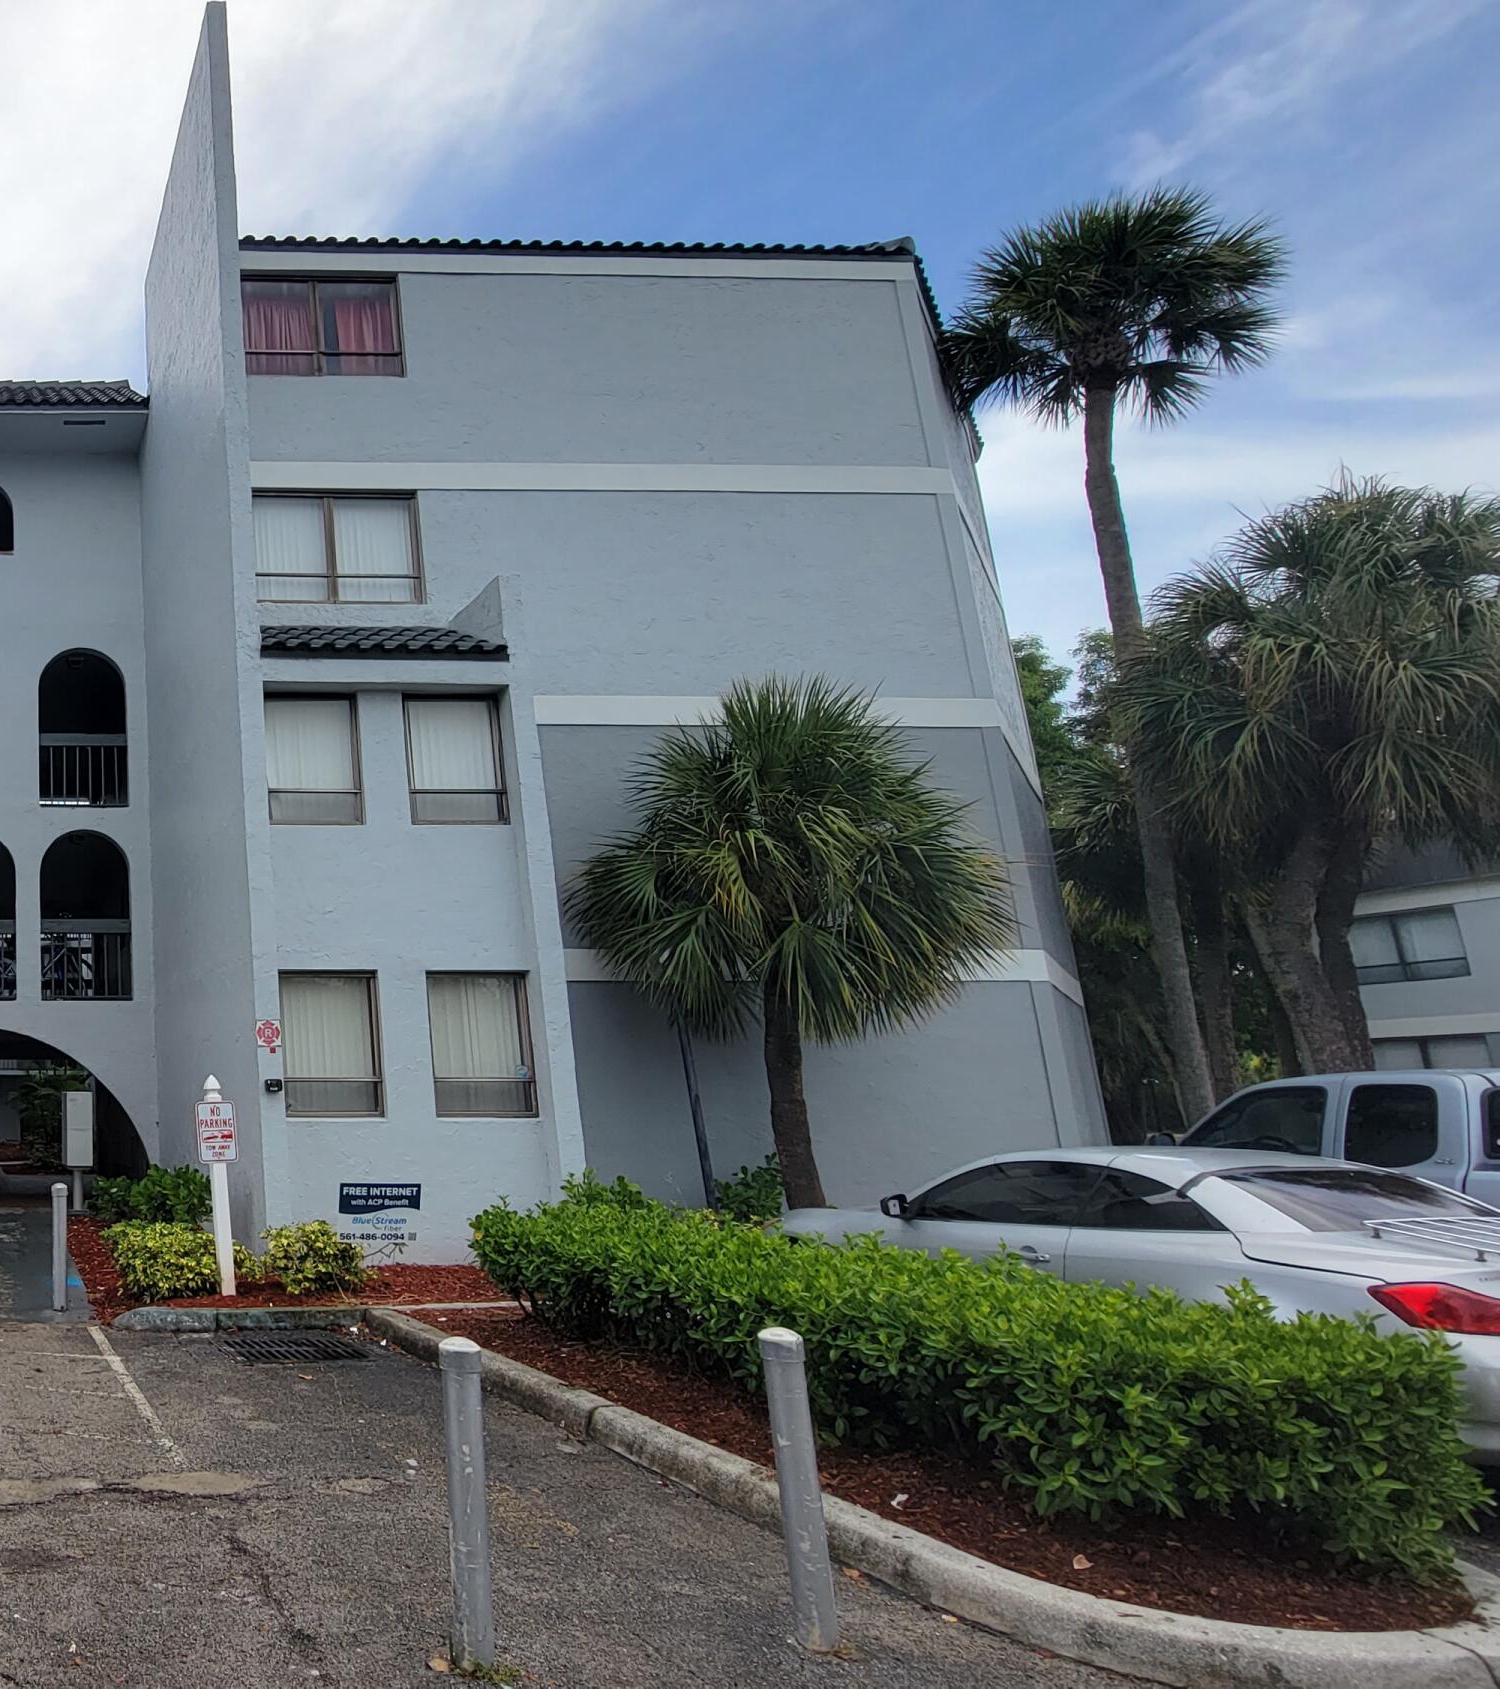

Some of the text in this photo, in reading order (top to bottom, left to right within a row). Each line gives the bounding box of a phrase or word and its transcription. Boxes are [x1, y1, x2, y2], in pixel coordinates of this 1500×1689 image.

[264, 1028, 273, 1038] R
[209, 1105, 221, 1117] NO
[200, 1118, 233, 1129] PARKING
[342, 1187, 418, 1196] FREE INTERNET
[340, 1233, 405, 1241] 561-486-0094
